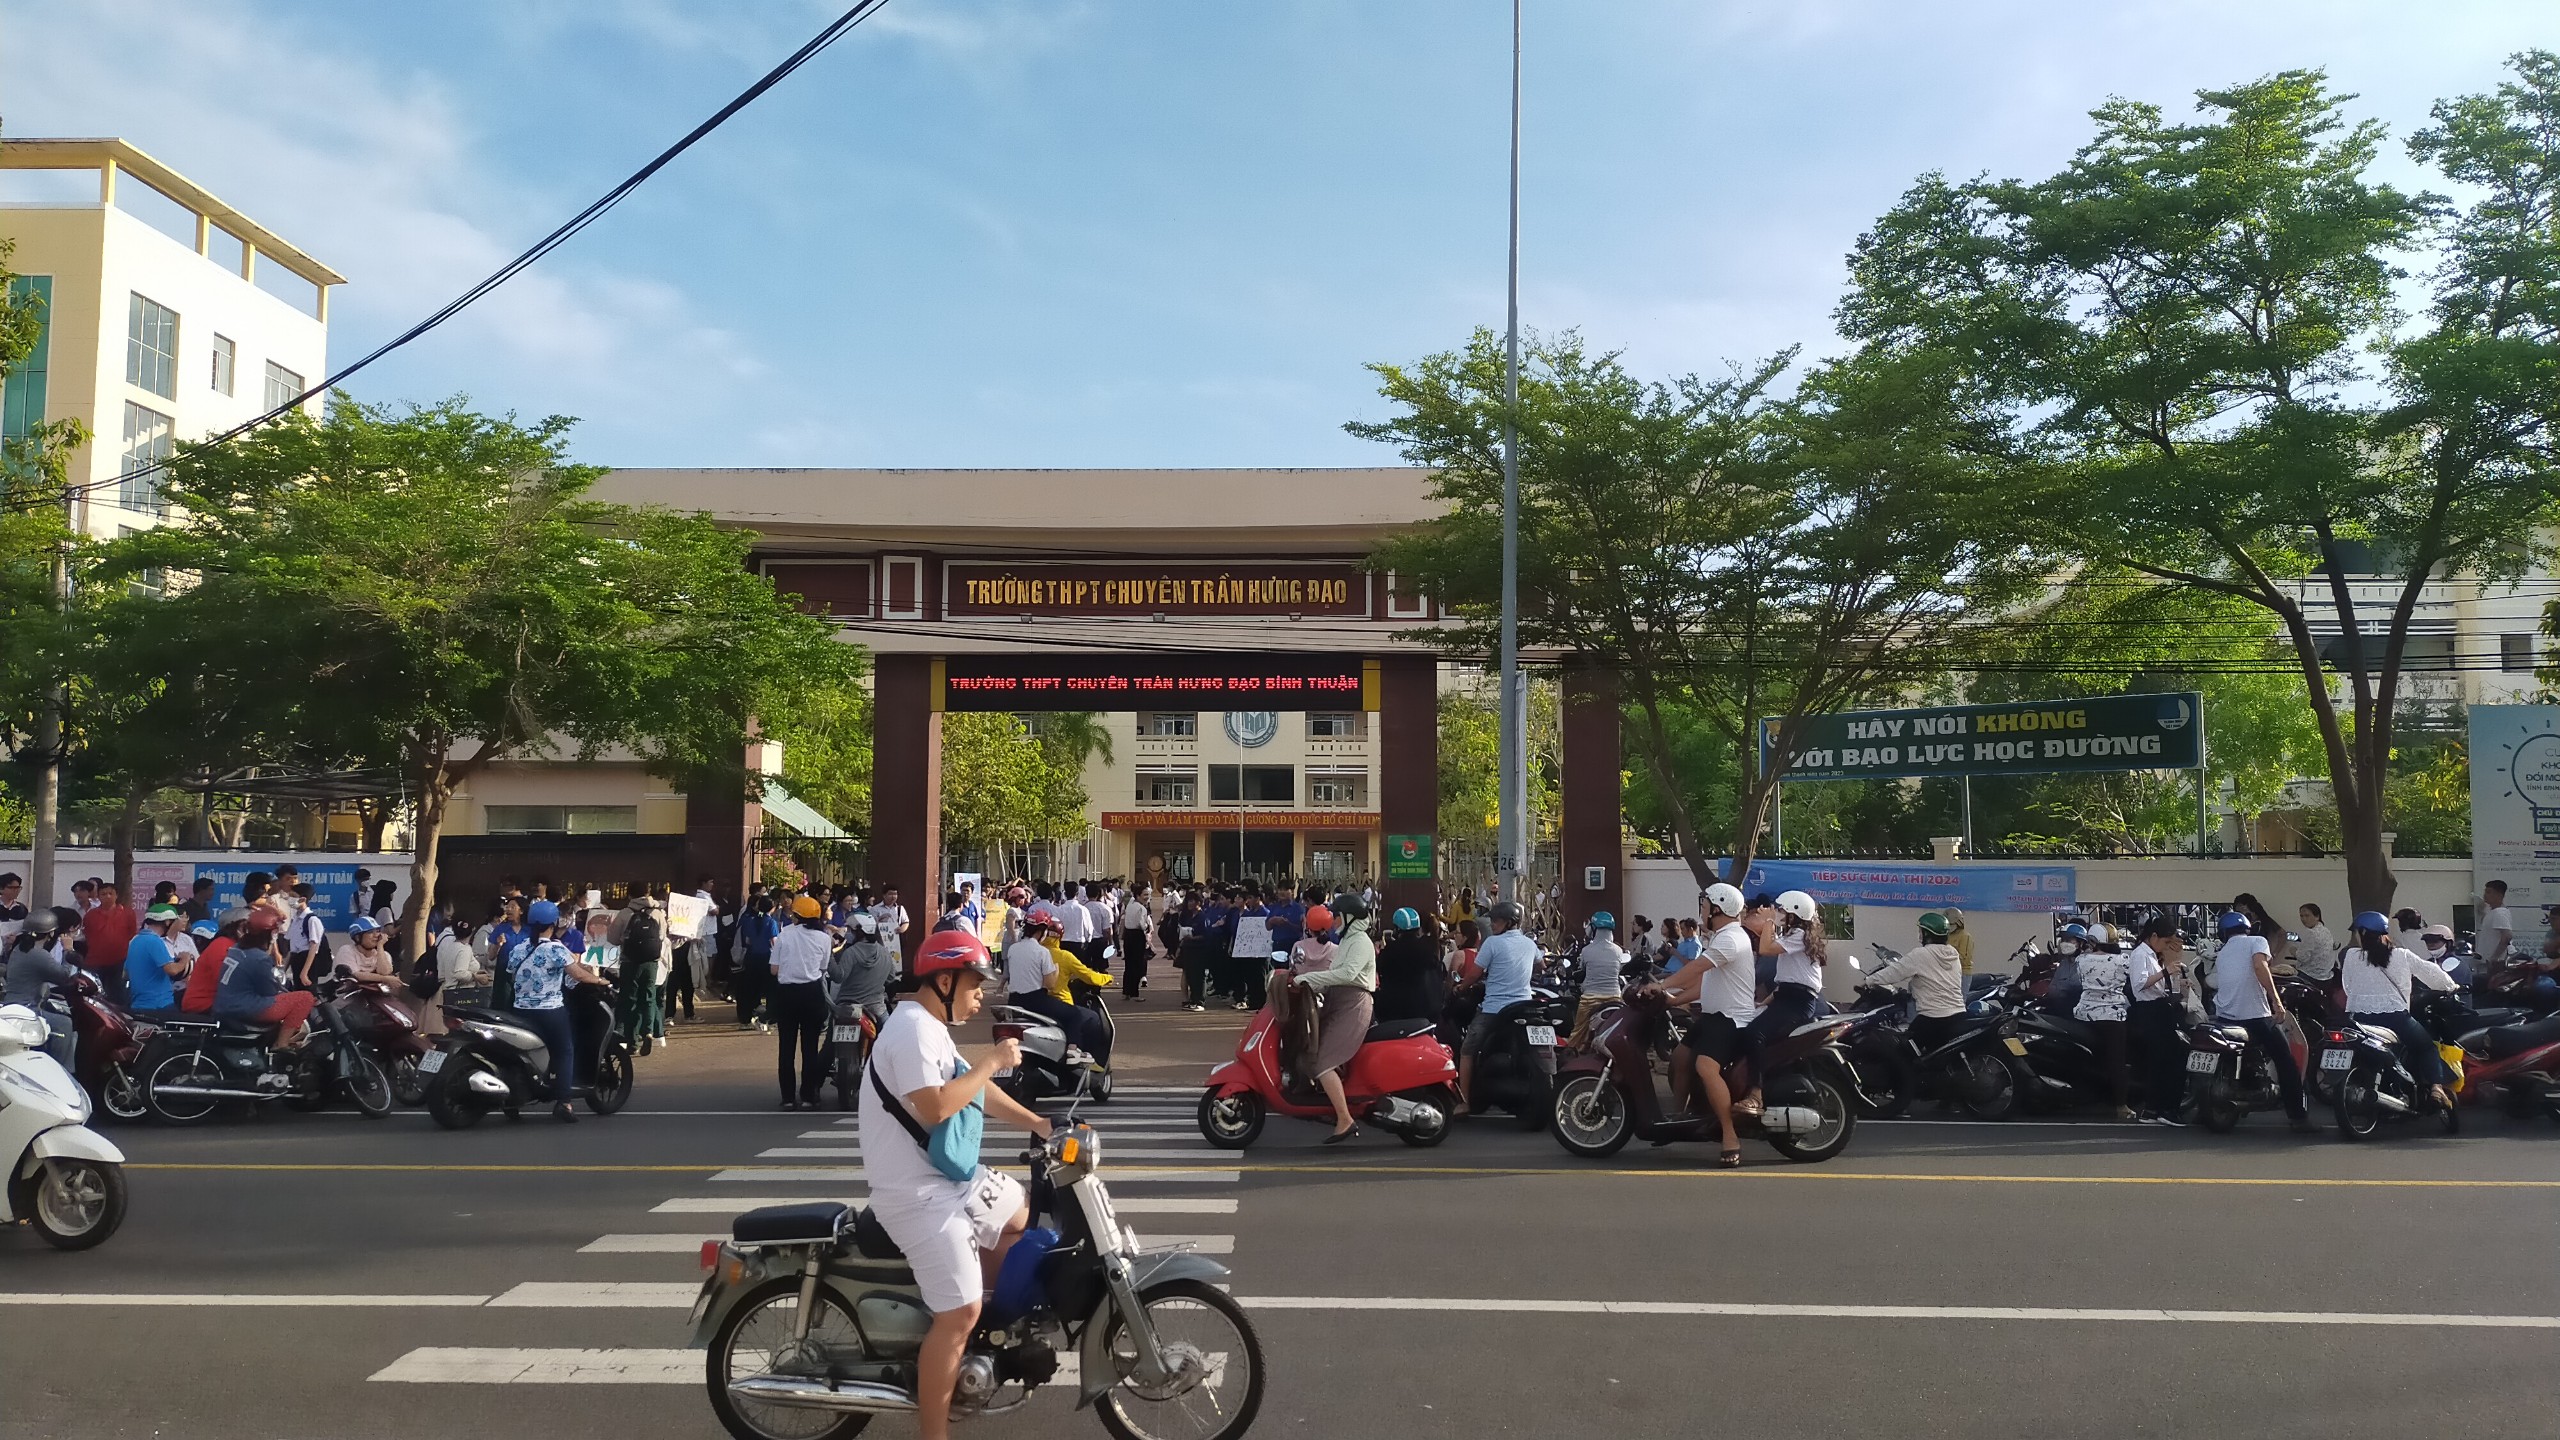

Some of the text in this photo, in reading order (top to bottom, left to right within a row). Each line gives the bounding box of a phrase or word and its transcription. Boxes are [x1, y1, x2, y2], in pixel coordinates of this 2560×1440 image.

[1046, 580, 1100, 604] THPT
[1105, 574, 1186, 604] CHUYÊN
[1190, 572, 1244, 604] TRẦN
[1248, 576, 1302, 604] HƯNG
[1307, 579, 1347, 609] ĐẠO
[1022, 678, 1062, 689] THPT
[1066, 675, 1128, 689] CHUYÊN
[1307, 675, 1359, 691] THUẬN
[1847, 709, 2087, 740] HÃY NÓI KHÔNG
[1841, 747, 1899, 768] BẠO
[1907, 744, 1965, 766] LỰC
[1974, 740, 2034, 763] HỌC
[2043, 733, 2161, 758] ĐƯỜNG
[1110, 815, 1131, 827] HỌC
[1133, 814, 1153, 826] TẬP
[1155, 813, 1167, 824] VÀ
[1169, 813, 1191, 824] LÀM
[1194, 815, 1221, 825] THEO
[1280, 815, 1300, 826] ĐẠO
[1338, 813, 1356, 824] CHÍ
[1500, 856, 1515, 871] 26
[315, 872, 328, 885] AN
[329, 870, 353, 885] TOÀN
[1811, 868, 1960, 885] TIẾP SỨC MÙA THI 2024
